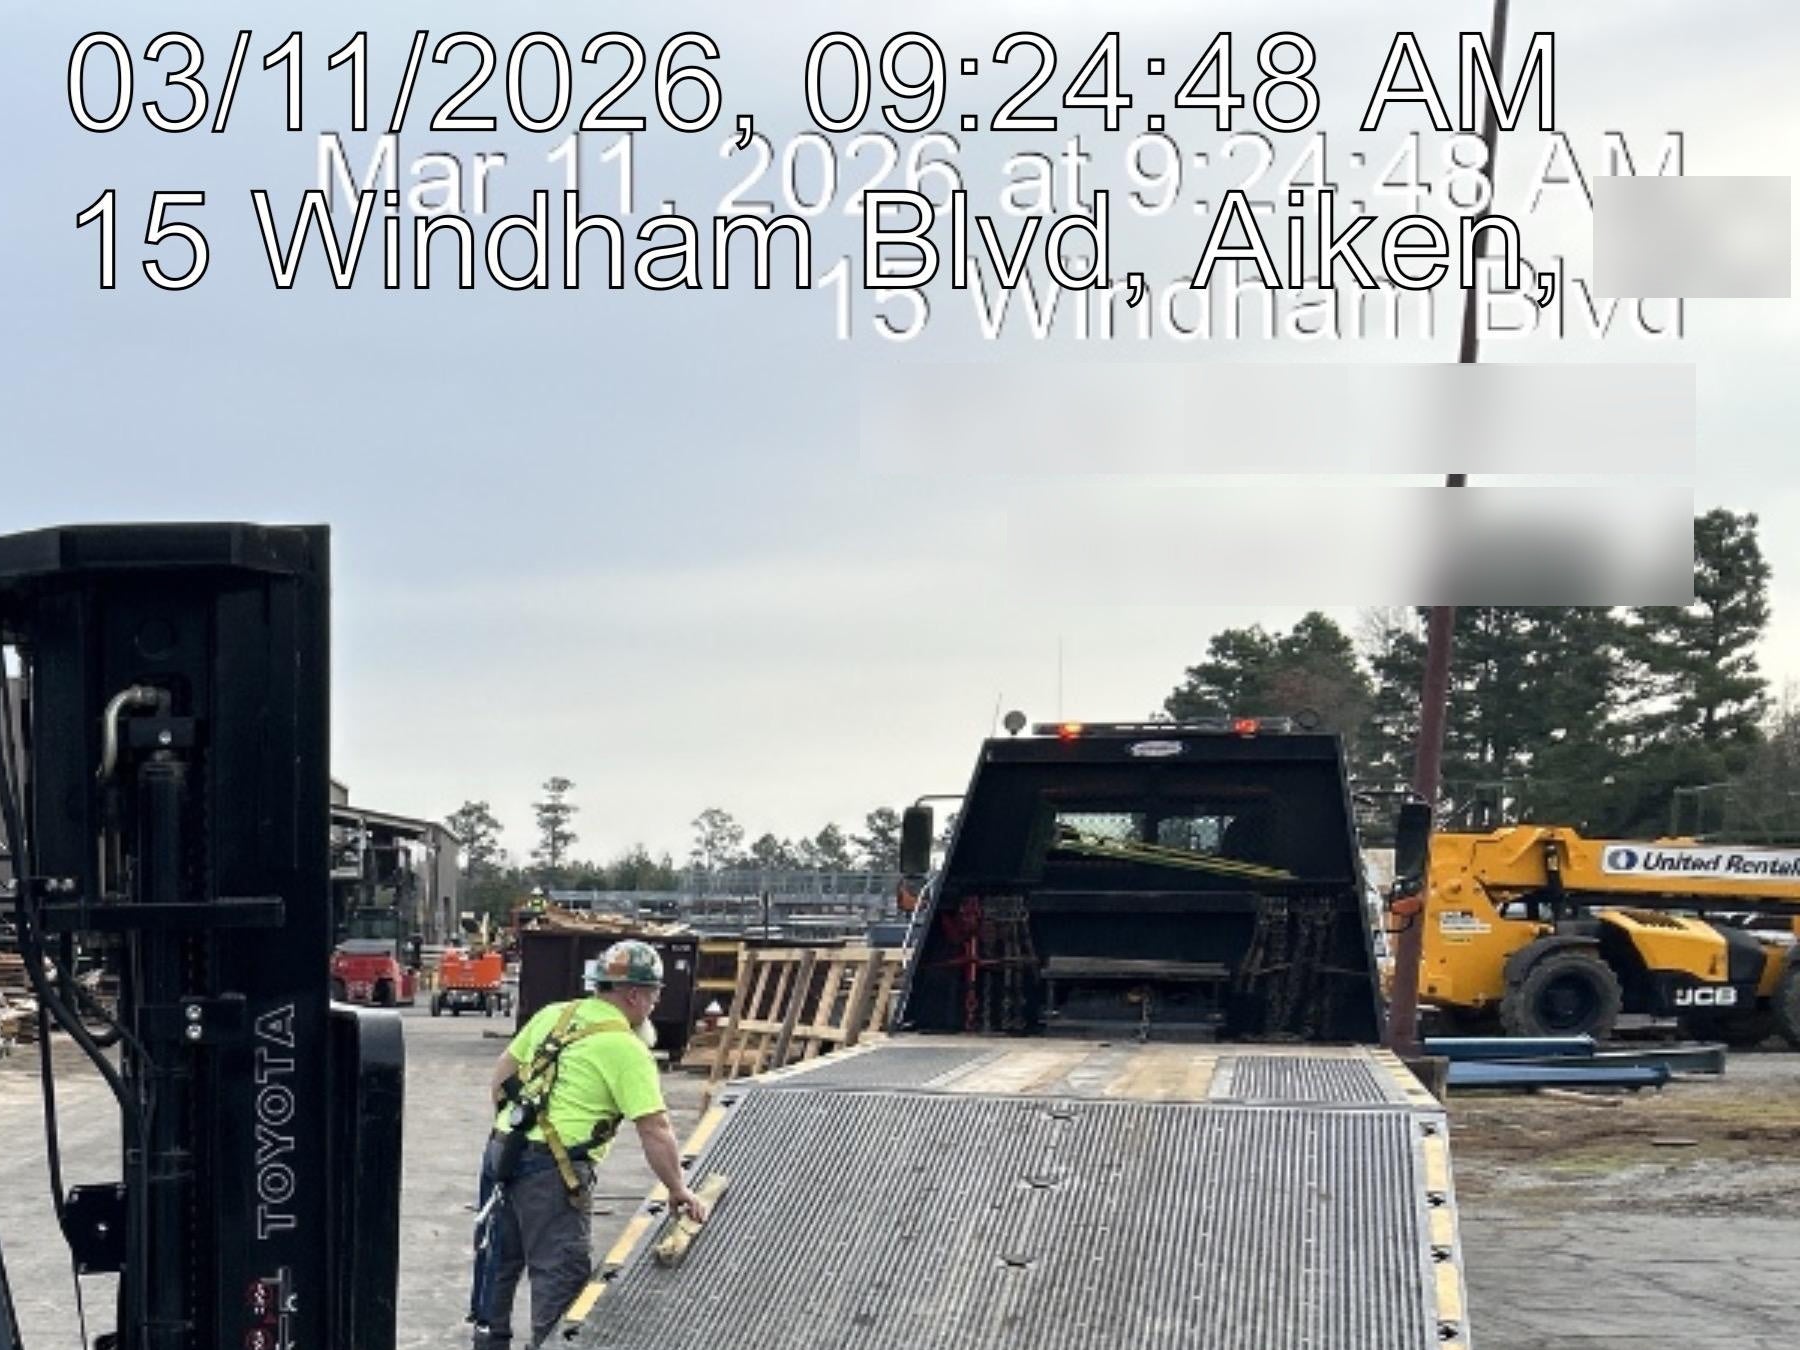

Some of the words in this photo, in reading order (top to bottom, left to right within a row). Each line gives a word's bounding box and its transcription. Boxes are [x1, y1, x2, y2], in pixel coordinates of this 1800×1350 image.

[1643, 852, 1722, 871] United
[1676, 986, 1737, 1006] JCB
[254, 1003, 296, 1240] TOYOTA
